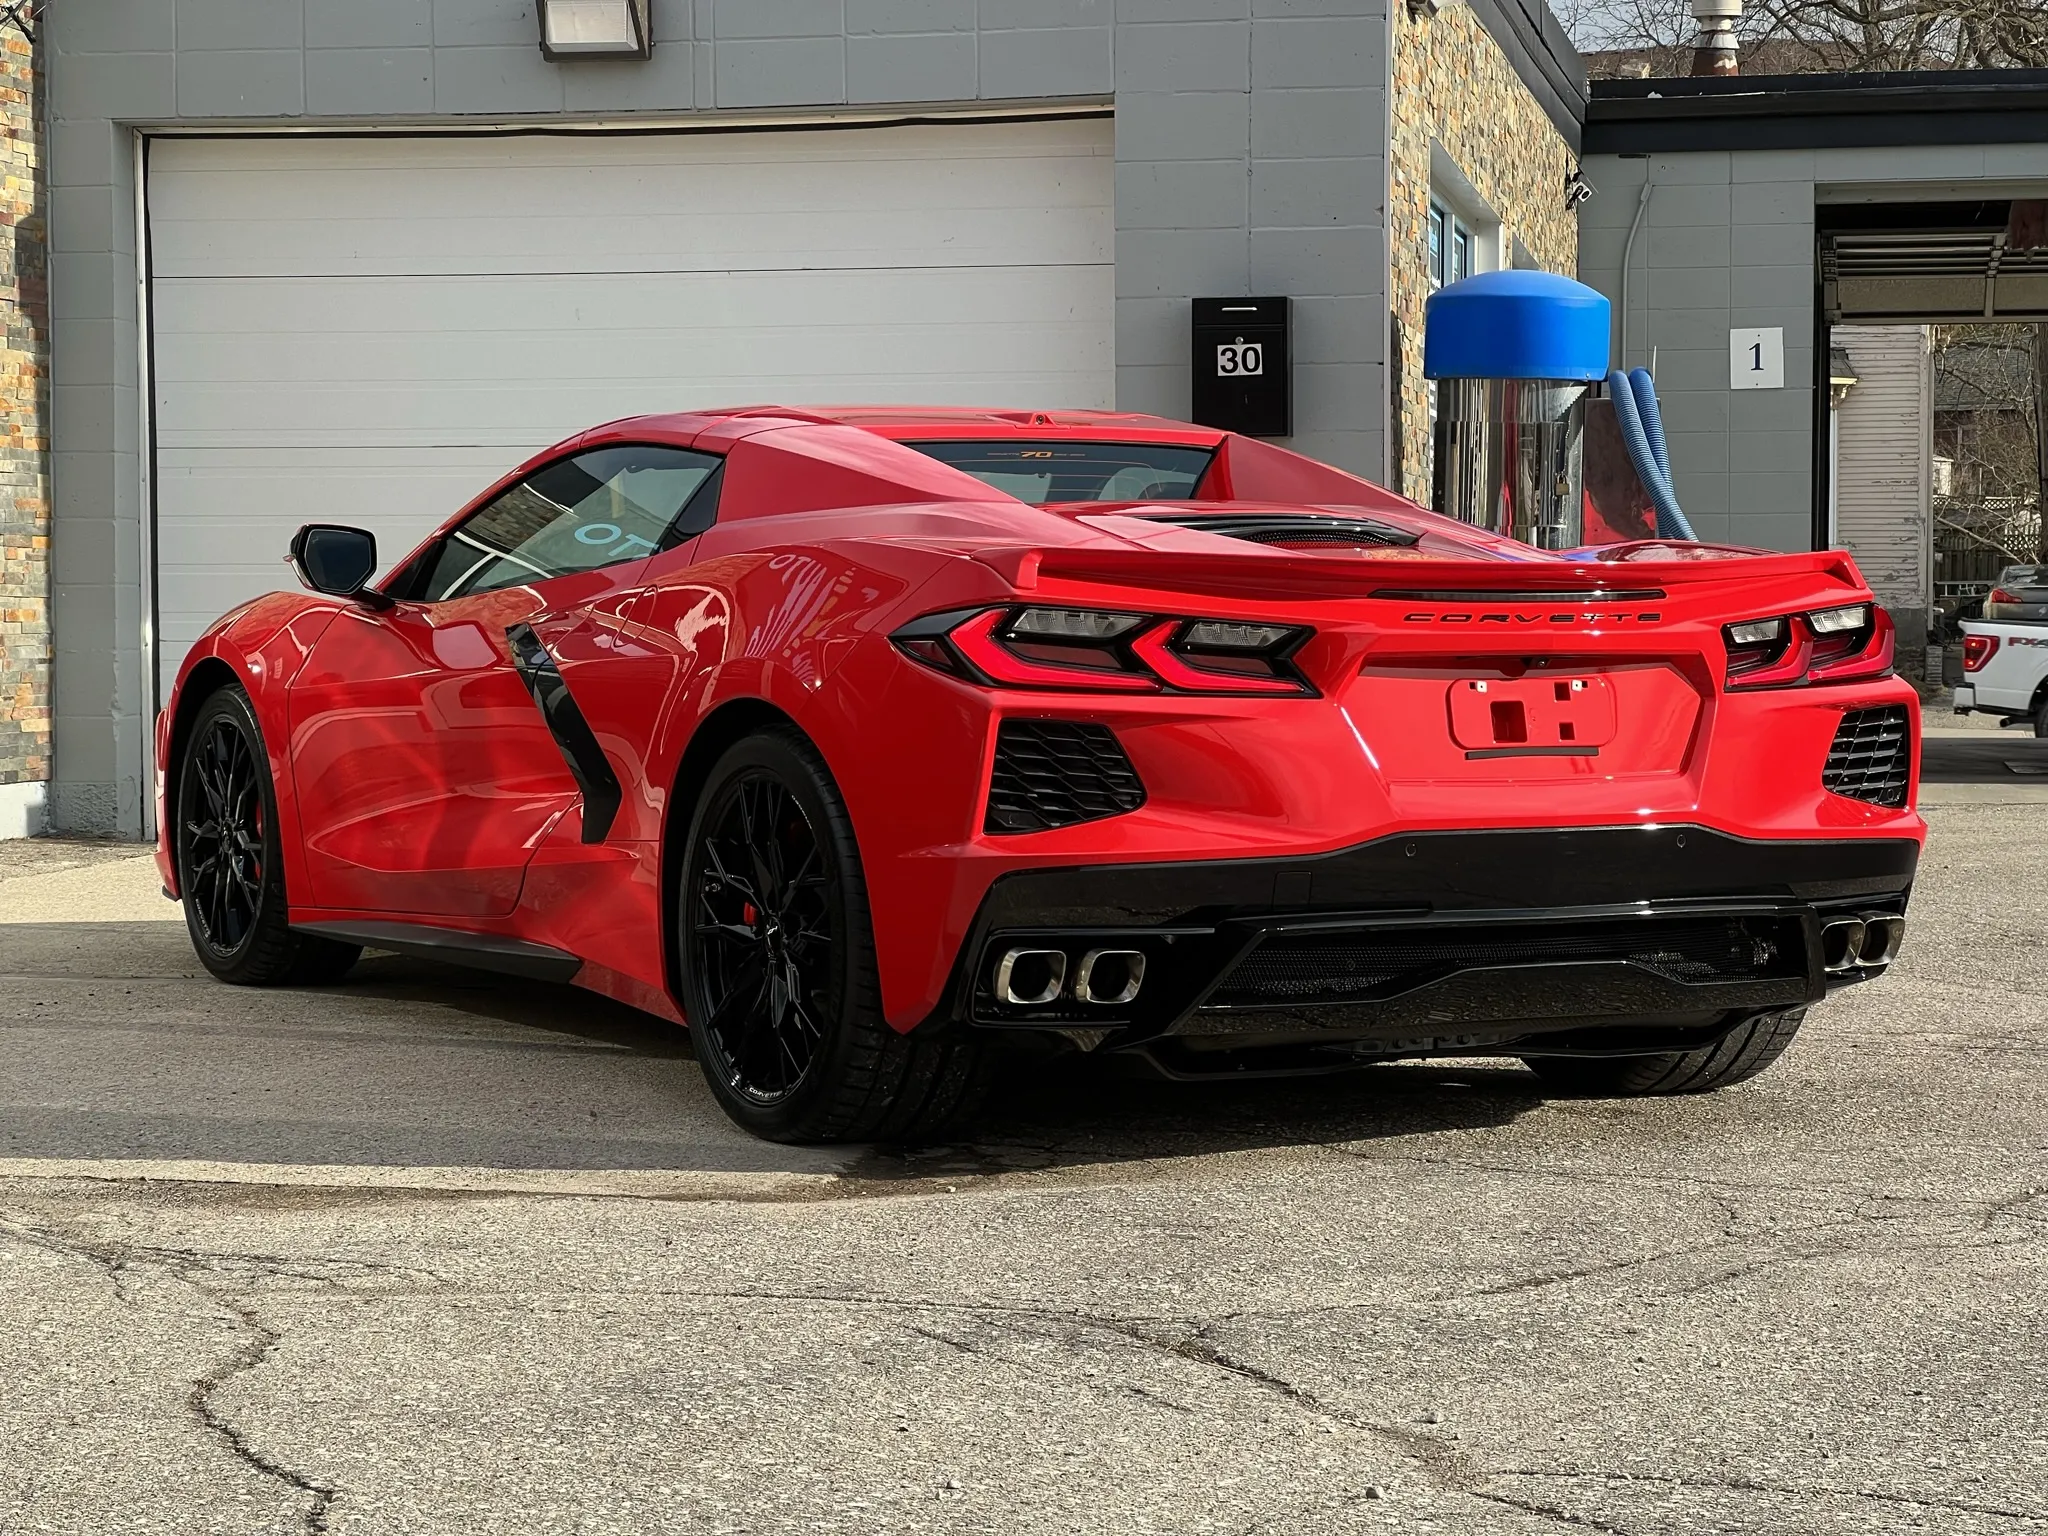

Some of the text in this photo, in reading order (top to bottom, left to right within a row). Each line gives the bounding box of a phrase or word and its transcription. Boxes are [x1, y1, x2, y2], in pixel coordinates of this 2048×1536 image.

[1220, 347, 1261, 374] 30
[1749, 342, 1764, 371] 1
[1403, 613, 1662, 623] CORVETTE
